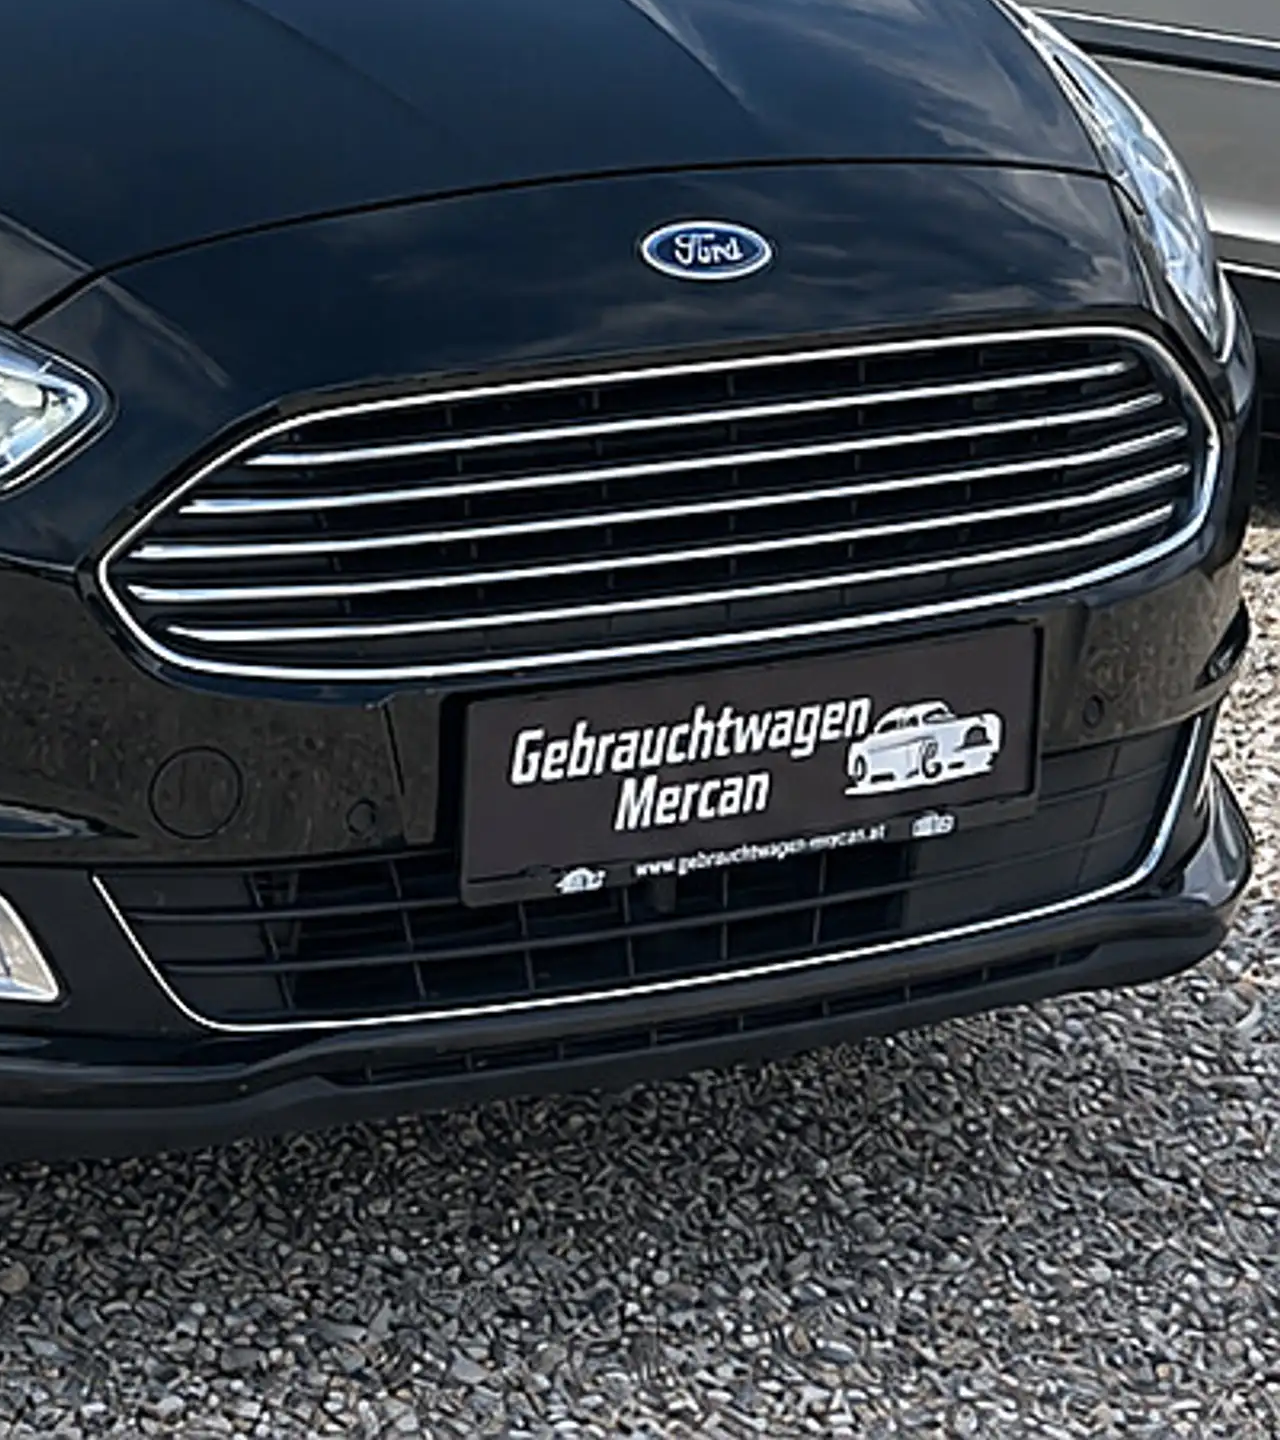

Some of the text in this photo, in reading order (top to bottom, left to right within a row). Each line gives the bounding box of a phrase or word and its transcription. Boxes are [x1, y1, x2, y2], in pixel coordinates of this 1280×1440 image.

[673, 232, 744, 266] Ford
[509, 695, 872, 786] Gebrauchtwagen
[613, 771, 770, 832] Mercan
